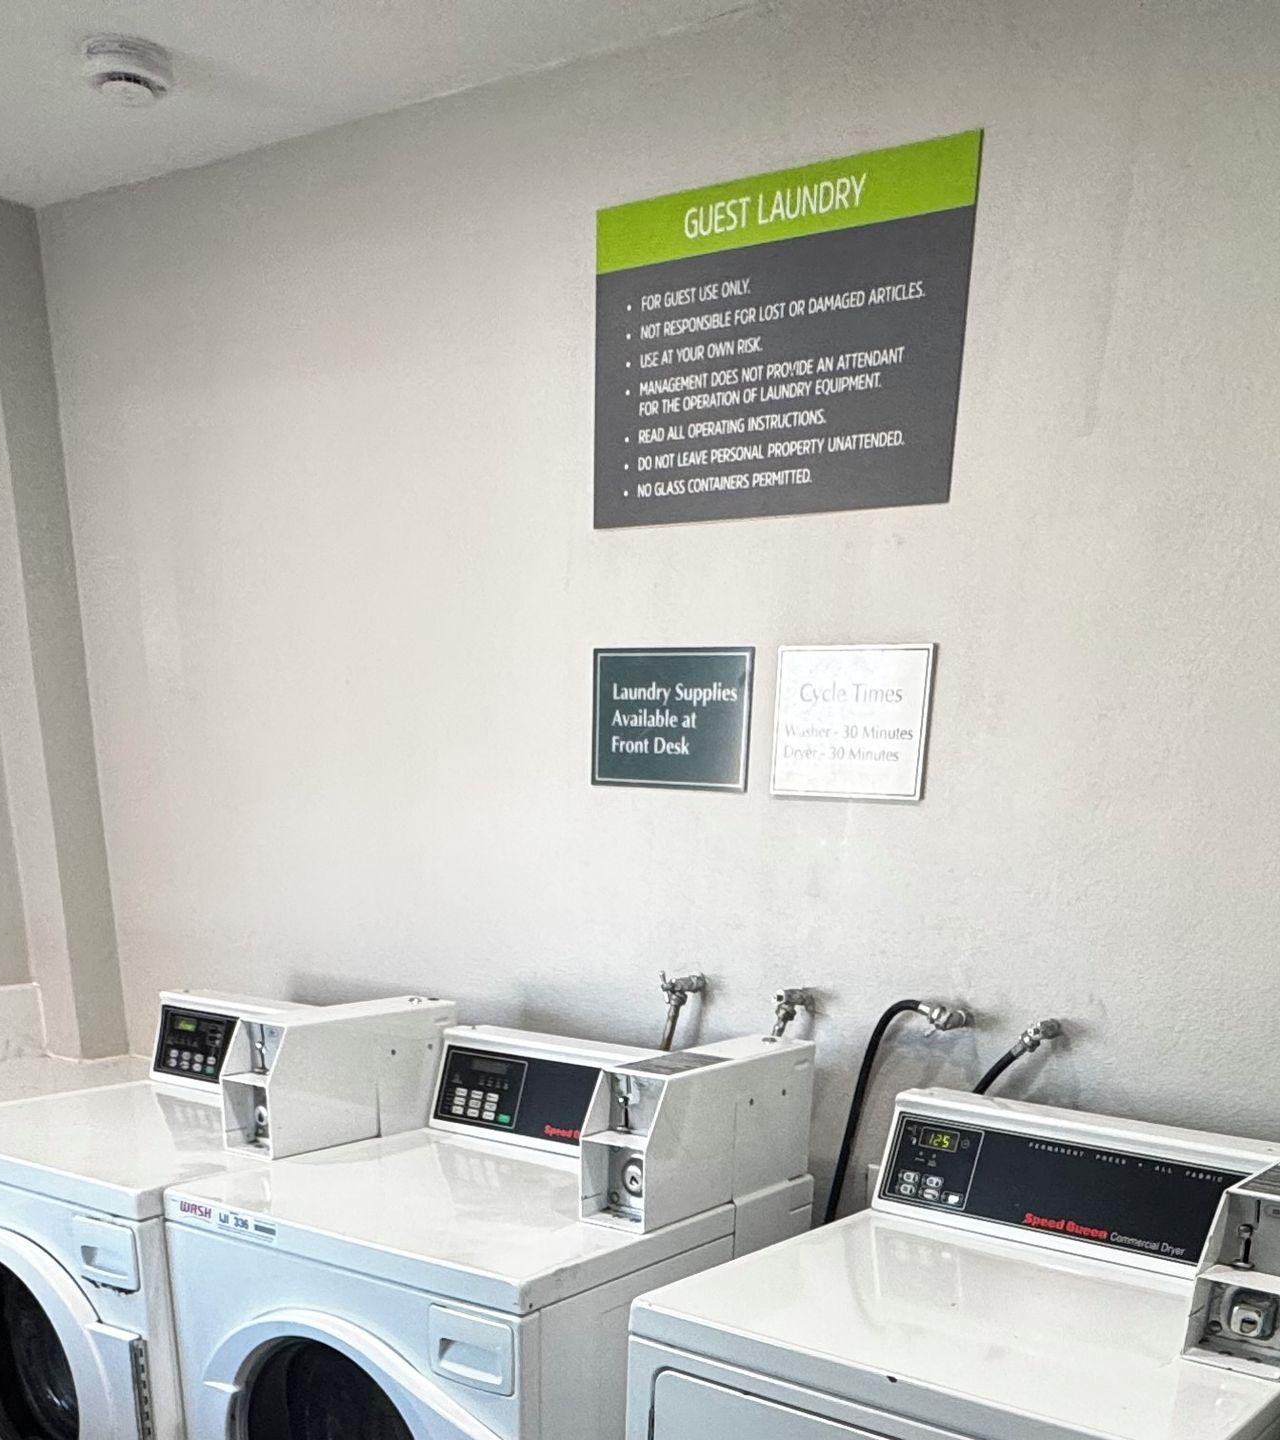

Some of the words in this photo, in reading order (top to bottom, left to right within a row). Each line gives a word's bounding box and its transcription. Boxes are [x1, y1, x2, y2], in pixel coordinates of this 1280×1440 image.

[684, 197, 750, 239] GUEST
[758, 173, 866, 225] LAUNDRY
[641, 294, 661, 312] FOR
[664, 287, 696, 307] GUEST
[699, 283, 719, 301] USE
[721, 277, 751, 298] ONLY.
[640, 323, 661, 340] NOT
[663, 310, 732, 337] RESPONSIBLE
[734, 307, 756, 326] FOR
[760, 302, 786, 322] LOST
[789, 299, 805, 317] OR
[808, 290, 865, 314] DAMAGED
[868, 281, 926, 306] ARTICLES.
[640, 351, 659, 368] USE
[661, 349, 674, 365] AT
[676, 344, 704, 363] YOUR
[707, 340, 735, 359] OWN
[737, 336, 763, 354] RISK.
[640, 373, 708, 396] MANAGEMENT
[711, 368, 738, 387] DOES
[742, 365, 764, 383] NOT
[766, 358, 814, 380] PROVIDE
[816, 356, 833, 373] AN
[837, 346, 905, 371] ATTENDANT
[639, 400, 659, 416] FOR
[662, 398, 680, 414] THE
[683, 390, 740, 411] OPERATION
[743, 387, 757, 404] OF
[760, 381, 812, 402] LAUNDRY
[815, 372, 882, 395] EQUIPMENT.
[639, 427, 664, 444] READ
[667, 425, 685, 440] ALL
[688, 418, 744, 438] OPERATING
[748, 408, 826, 431] INSTRUCTIONS.
[638, 456, 652, 471] DO
[655, 453, 674, 469] NOT
[677, 450, 708, 467] LEAVE
[710, 444, 764, 463] PERSONAL
[767, 438, 824, 458] PROPERTY
[827, 430, 905, 452] UNATTENDED.
[638, 483, 652, 498] NO
[654, 480, 685, 497] GLASS
[688, 474, 749, 493] CONTAINERS
[752, 468, 812, 488] PERMITTED.
[612, 682, 671, 706] Laundry
[674, 682, 738, 707] Supplies
[799, 680, 847, 706] Cycle
[852, 682, 903, 703] Times
[611, 709, 678, 728] Available
[681, 713, 696, 729] at
[843, 725, 858, 739] 30
[862, 726, 913, 740] Minutes
[611, 736, 649, 754] Front
[653, 736, 690, 756] Desk
[783, 745, 818, 760] Dryer
[831, 746, 845, 760] 30
[848, 747, 899, 761] Minutes
[1029, 1142, 1084, 1157] PERMANENT
[180, 1200, 212, 1219] WASH
[1022, 1212, 1066, 1231] Speed
[1066, 1221, 1108, 1240] Queen
[1110, 1231, 1160, 1251] Commercial
[1161, 1241, 1186, 1256] Dryer
